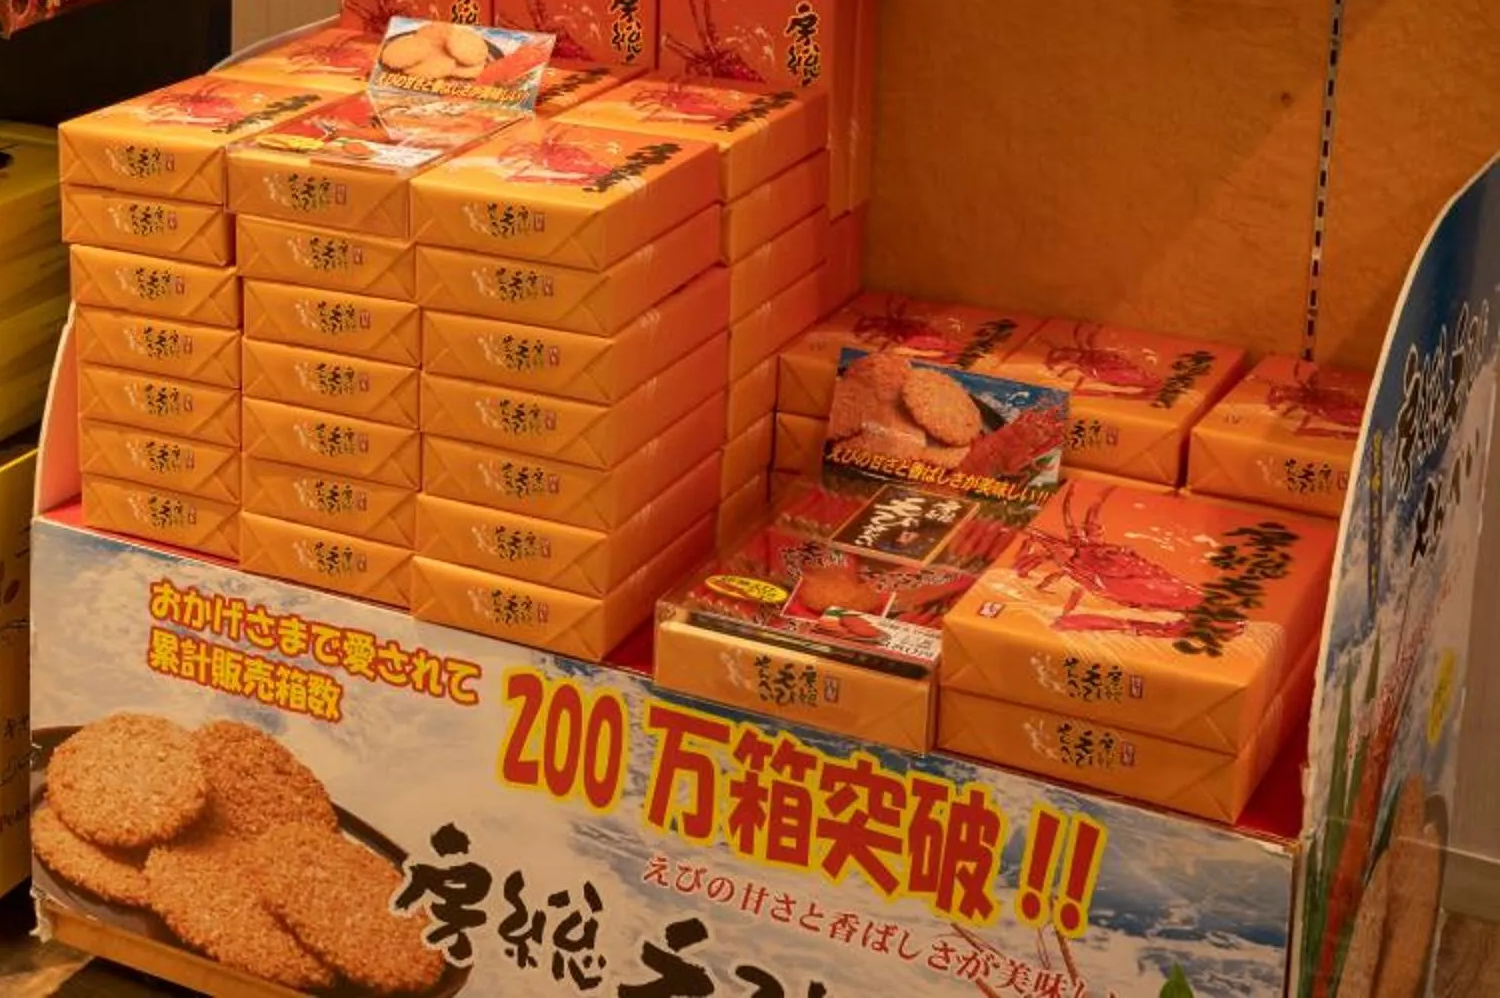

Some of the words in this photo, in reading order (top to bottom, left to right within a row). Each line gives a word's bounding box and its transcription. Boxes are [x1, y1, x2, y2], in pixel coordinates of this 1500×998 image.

[147, 629, 344, 724] 累計販売箱数
[149, 578, 482, 705] おかげさまで愛されて
